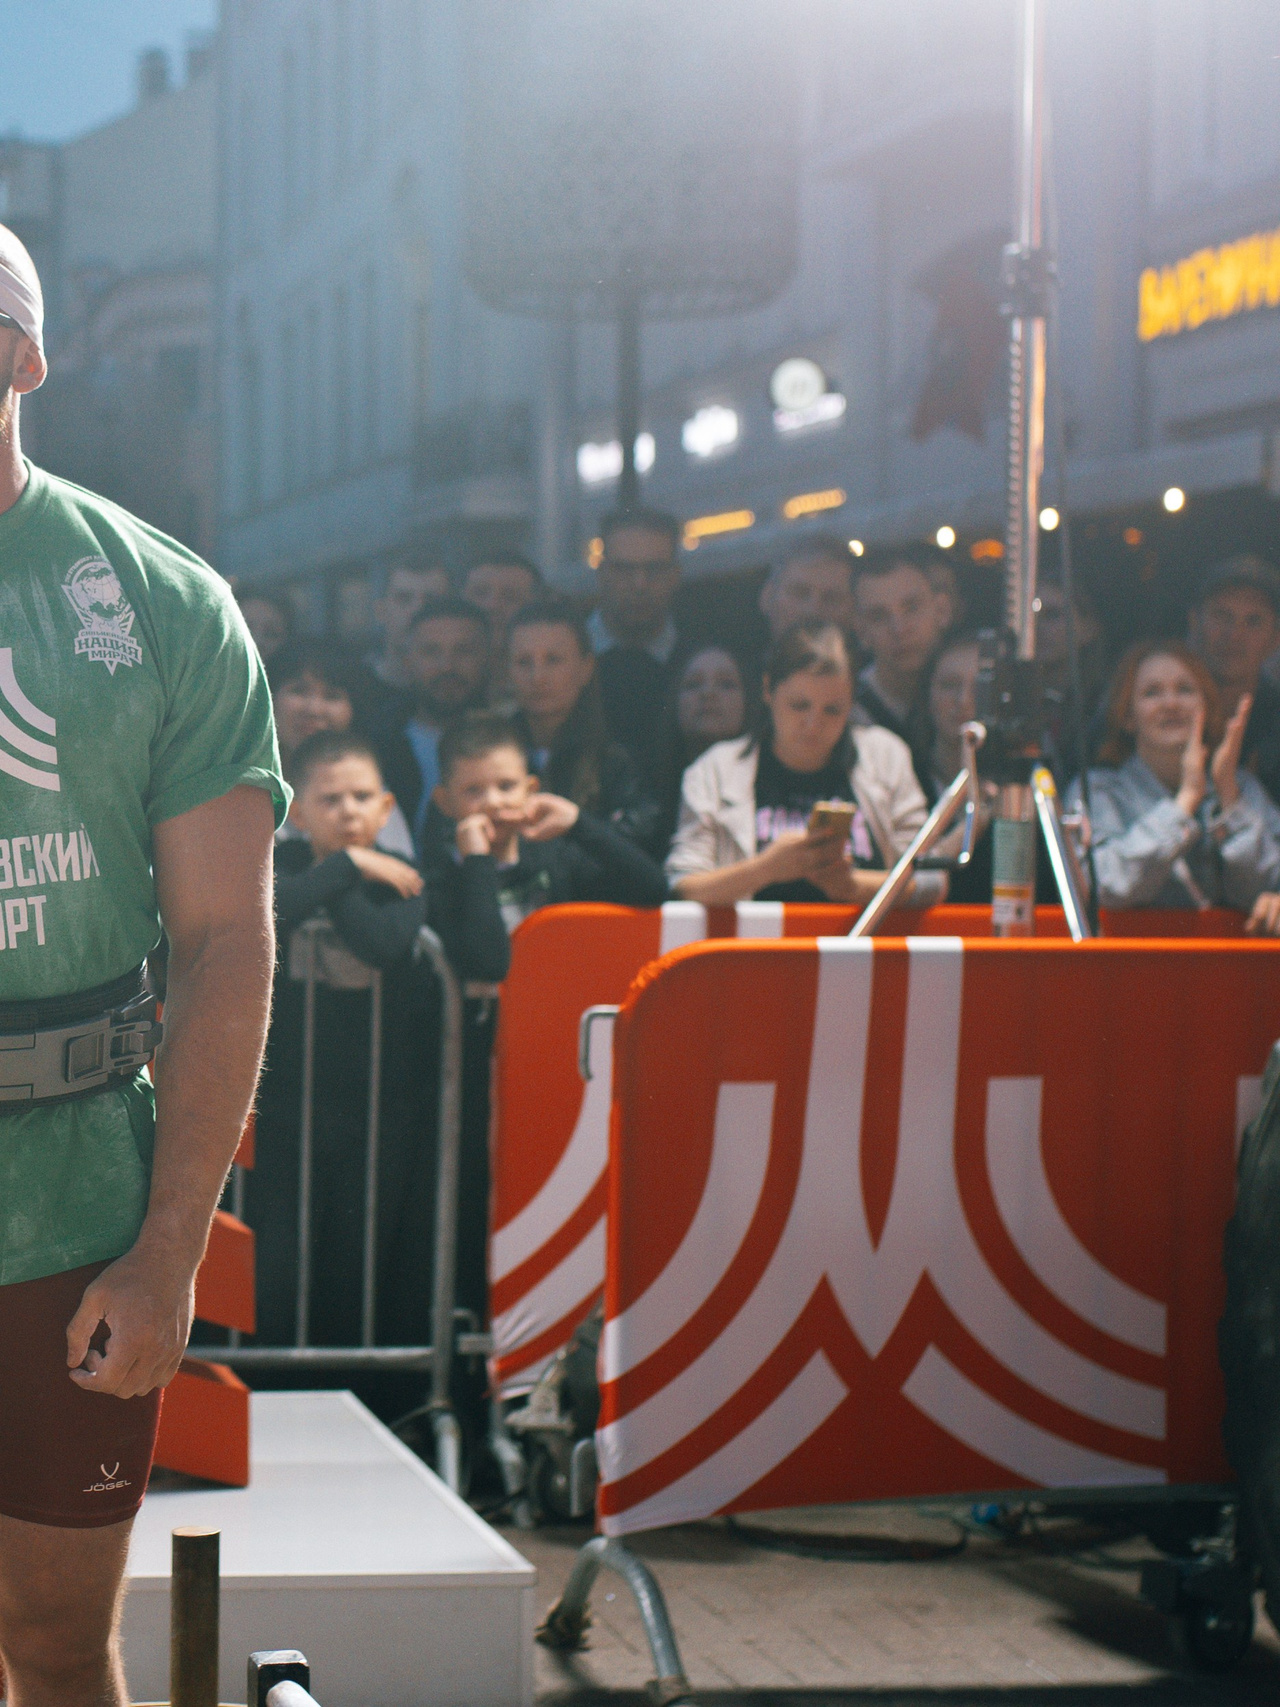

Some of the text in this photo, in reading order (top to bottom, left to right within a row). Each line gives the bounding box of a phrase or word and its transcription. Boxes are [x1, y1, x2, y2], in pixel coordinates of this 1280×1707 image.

[78, 637, 139, 660] НАЦИЯ
[91, 649, 130, 663] МИРА
[82, 1480, 132, 1492] JÖGEL
